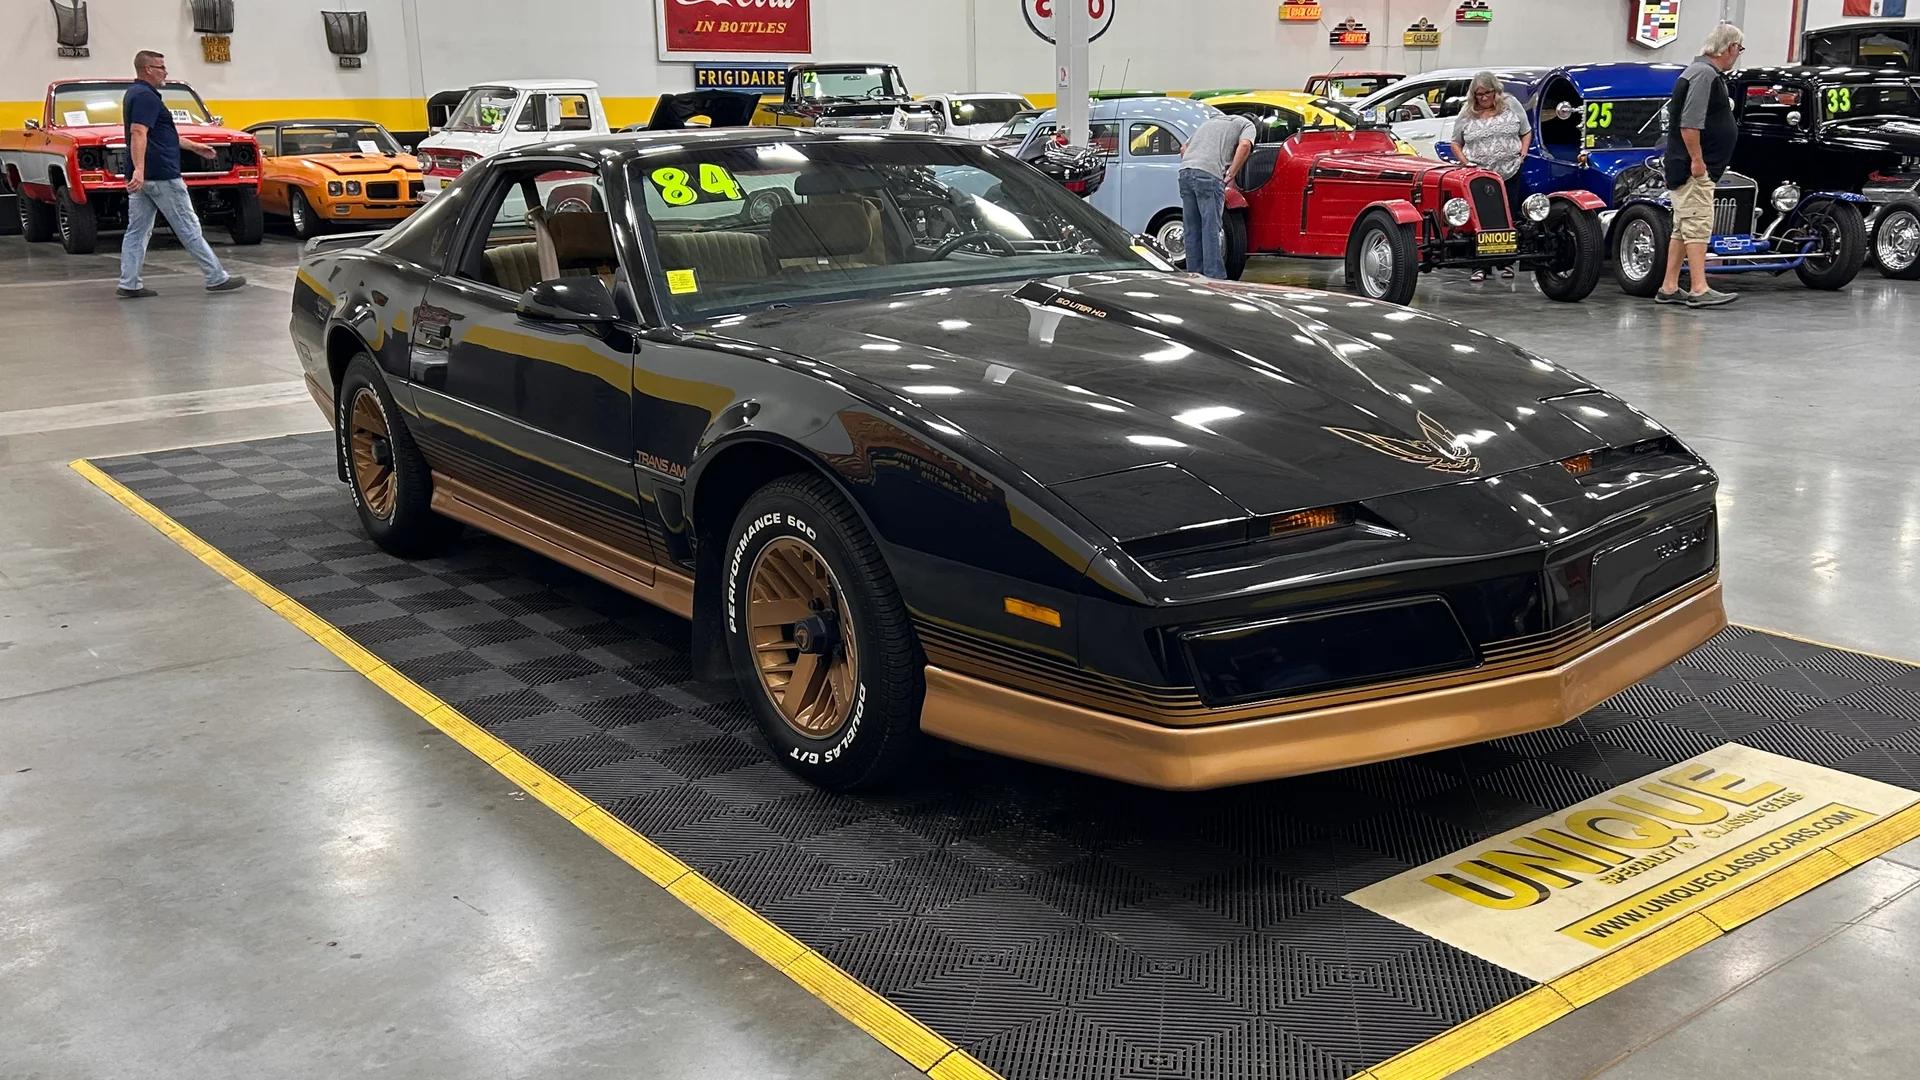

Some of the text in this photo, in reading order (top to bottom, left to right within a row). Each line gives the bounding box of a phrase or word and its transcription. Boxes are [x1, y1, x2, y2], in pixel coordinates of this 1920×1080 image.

[694, 21, 787, 34] IN BOTTLES
[698, 70, 785, 85] FRIGIDAIRE
[1586, 102, 1614, 128] 25
[1827, 87, 1850, 113] 33
[651, 163, 742, 206] 84
[1477, 232, 1516, 243] UNIQUE
[1069, 301, 1092, 314] LITER
[1091, 309, 1108, 318] HO
[636, 449, 688, 480] TRANS AM
[728, 512, 817, 634] PERFORMANCE 600
[789, 681, 867, 765] DOUGLAS G/T
[1423, 763, 1787, 910] UNIQUE
[1597, 845, 1685, 885] SPECIALTY
[1701, 808, 1767, 839] CLASSIC
[1756, 791, 1805, 814] CARS
[1584, 810, 1855, 939] WWW.UNIQUECLASSICCARS.COM
